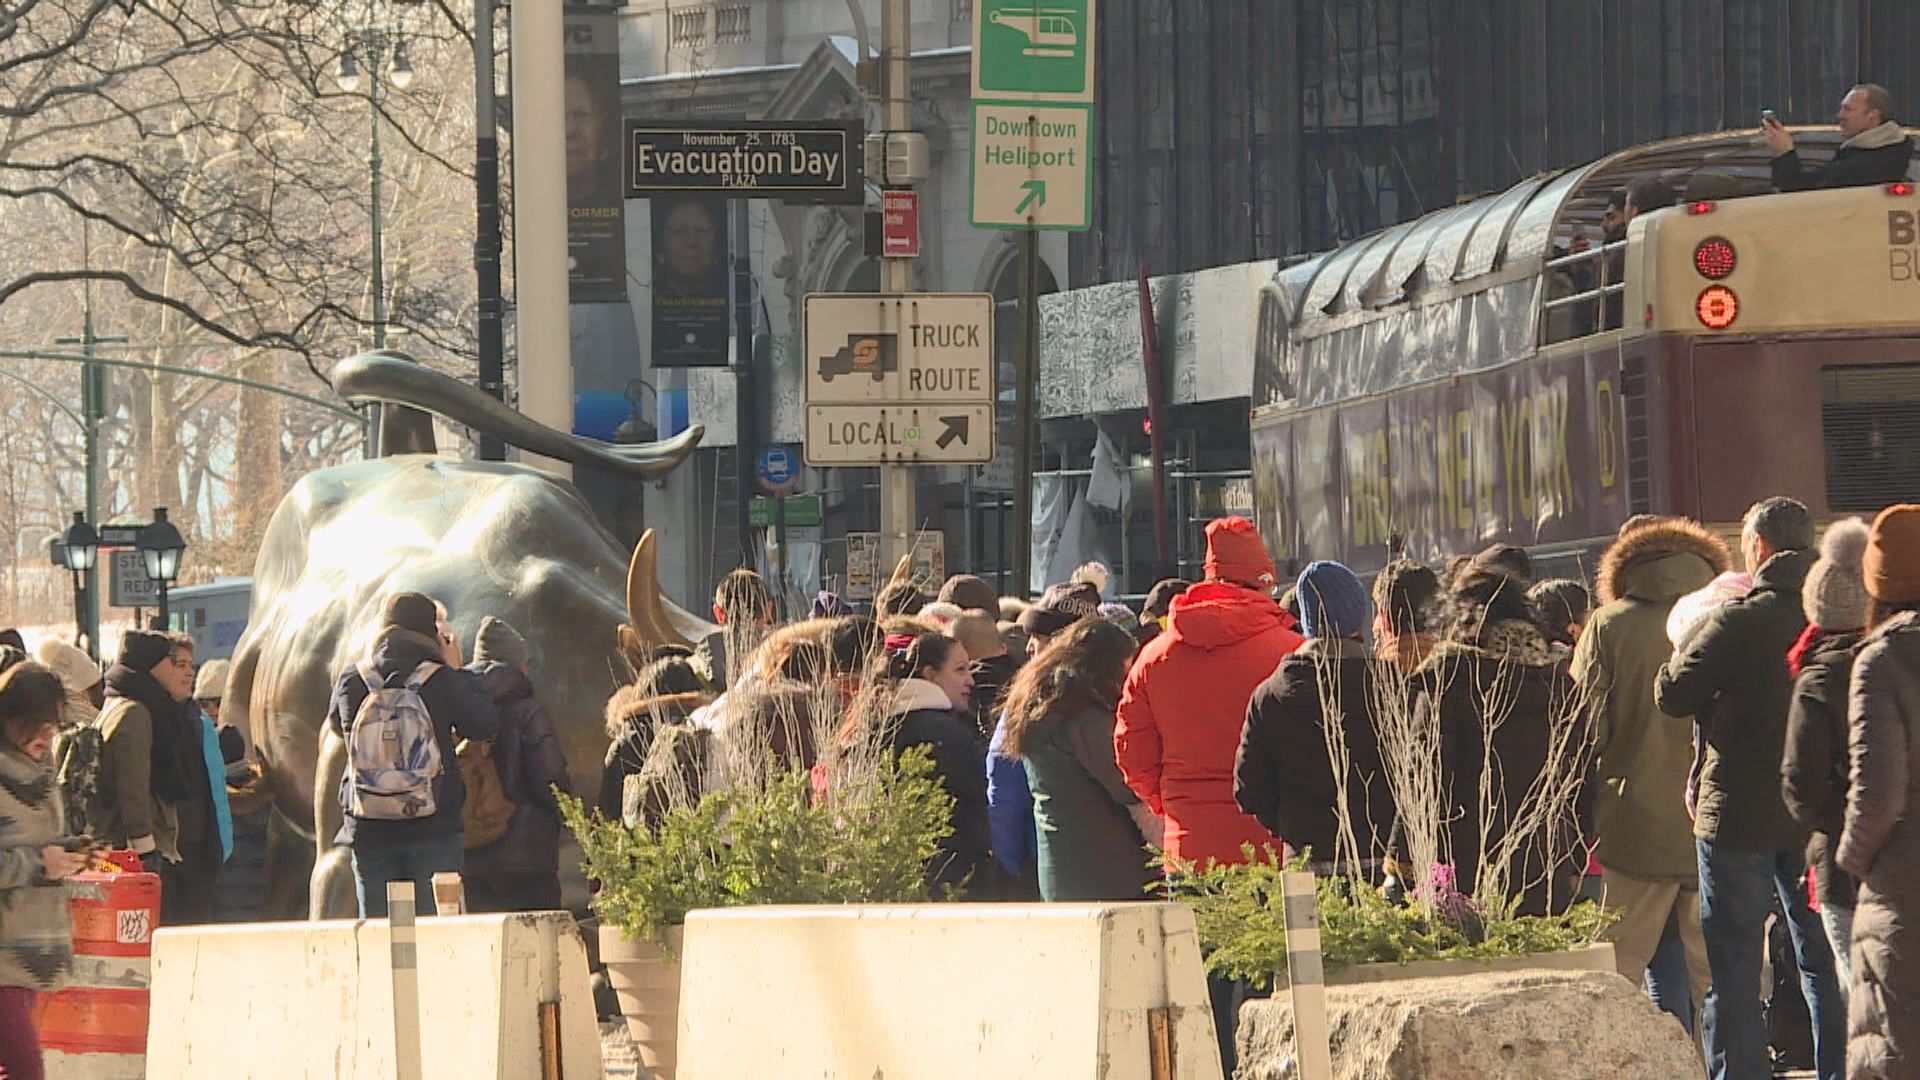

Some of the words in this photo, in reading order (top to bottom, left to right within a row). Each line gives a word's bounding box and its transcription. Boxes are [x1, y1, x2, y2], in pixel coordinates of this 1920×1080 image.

[985, 116, 1076, 138] Downtown
[682, 133, 737, 146] November
[770, 133, 796, 146] 1783
[639, 143, 782, 174] Evacuation
[790, 146, 839, 181] Day
[985, 144, 1075, 169] Heliport
[721, 174, 757, 186] PLAZA
[909, 324, 980, 347] TRUCK
[909, 368, 981, 391] ROUTE
[828, 422, 902, 445] LOCAL
[1501, 380, 1573, 526] YORK
[119, 554, 146, 569] STO
